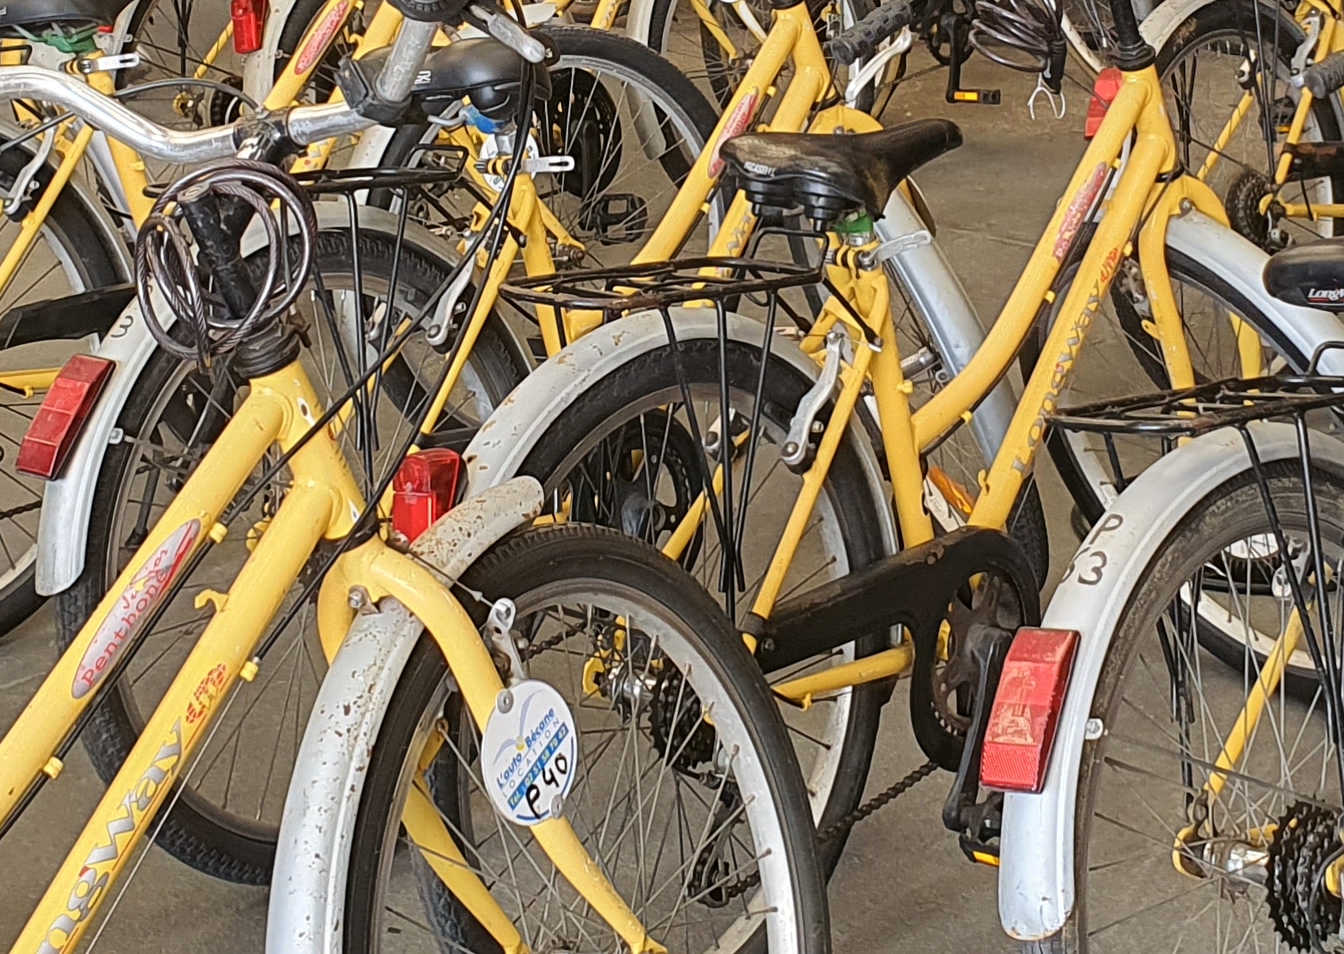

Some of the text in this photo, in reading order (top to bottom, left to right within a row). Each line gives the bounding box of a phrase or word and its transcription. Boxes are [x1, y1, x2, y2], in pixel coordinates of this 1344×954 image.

[1088, 513, 1123, 545] P
[524, 707, 556, 750] Bécane
[525, 751, 568, 820] P 40
